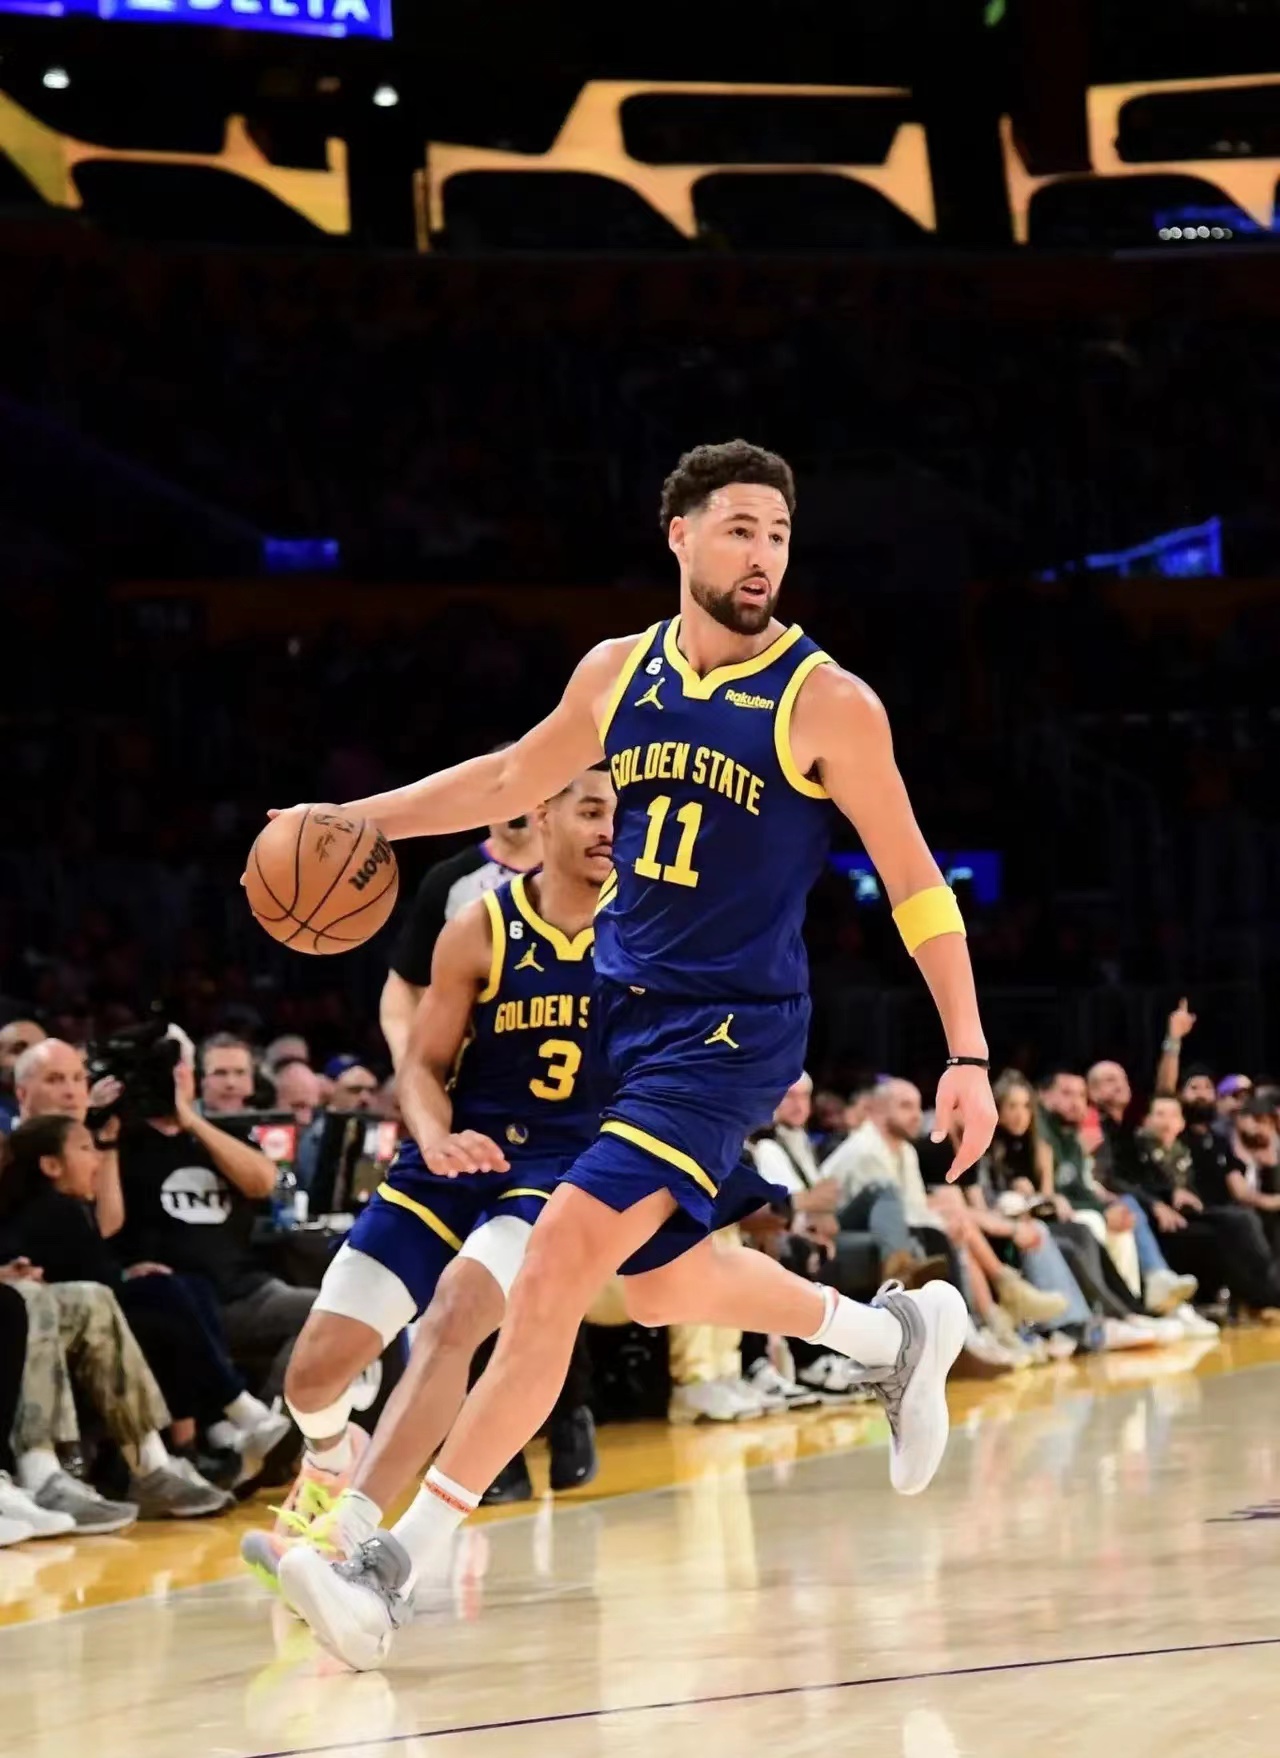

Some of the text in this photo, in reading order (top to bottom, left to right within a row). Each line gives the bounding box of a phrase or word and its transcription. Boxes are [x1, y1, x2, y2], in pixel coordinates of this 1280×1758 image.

[645, 657, 664, 675] 6
[725, 688, 774, 710] Rakuten
[611, 741, 765, 816] GOLDEN STATE
[348, 828, 391, 891] ilson
[634, 794, 703, 888] 11
[509, 920, 524, 940] 6
[494, 994, 575, 1034] GOLDEN
[529, 1038, 582, 1102] 3
